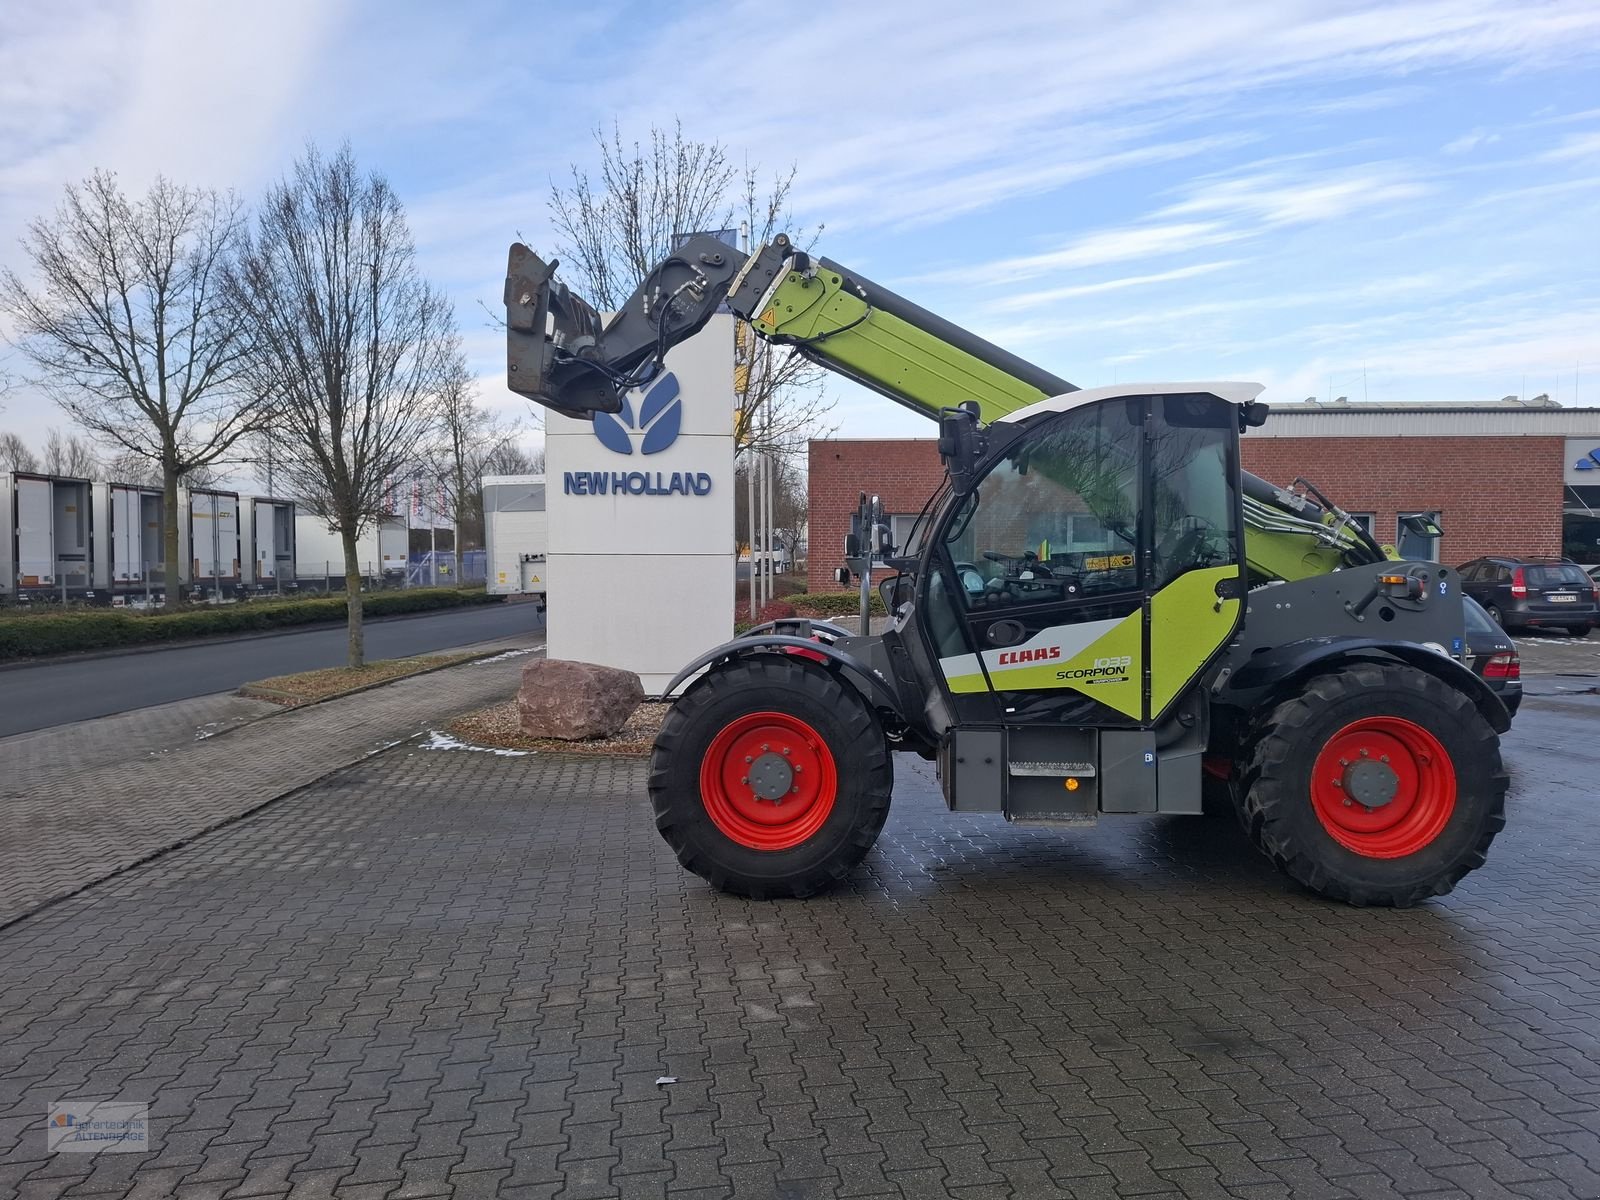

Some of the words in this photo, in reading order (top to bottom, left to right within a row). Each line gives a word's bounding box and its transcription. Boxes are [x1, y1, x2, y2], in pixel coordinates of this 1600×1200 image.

[563, 471, 608, 495] NEW
[611, 471, 712, 495] HOLLAND
[999, 646, 1061, 665] CLAAS
[1094, 656, 1132, 668] 1033
[1056, 666, 1126, 680] SCORPION
